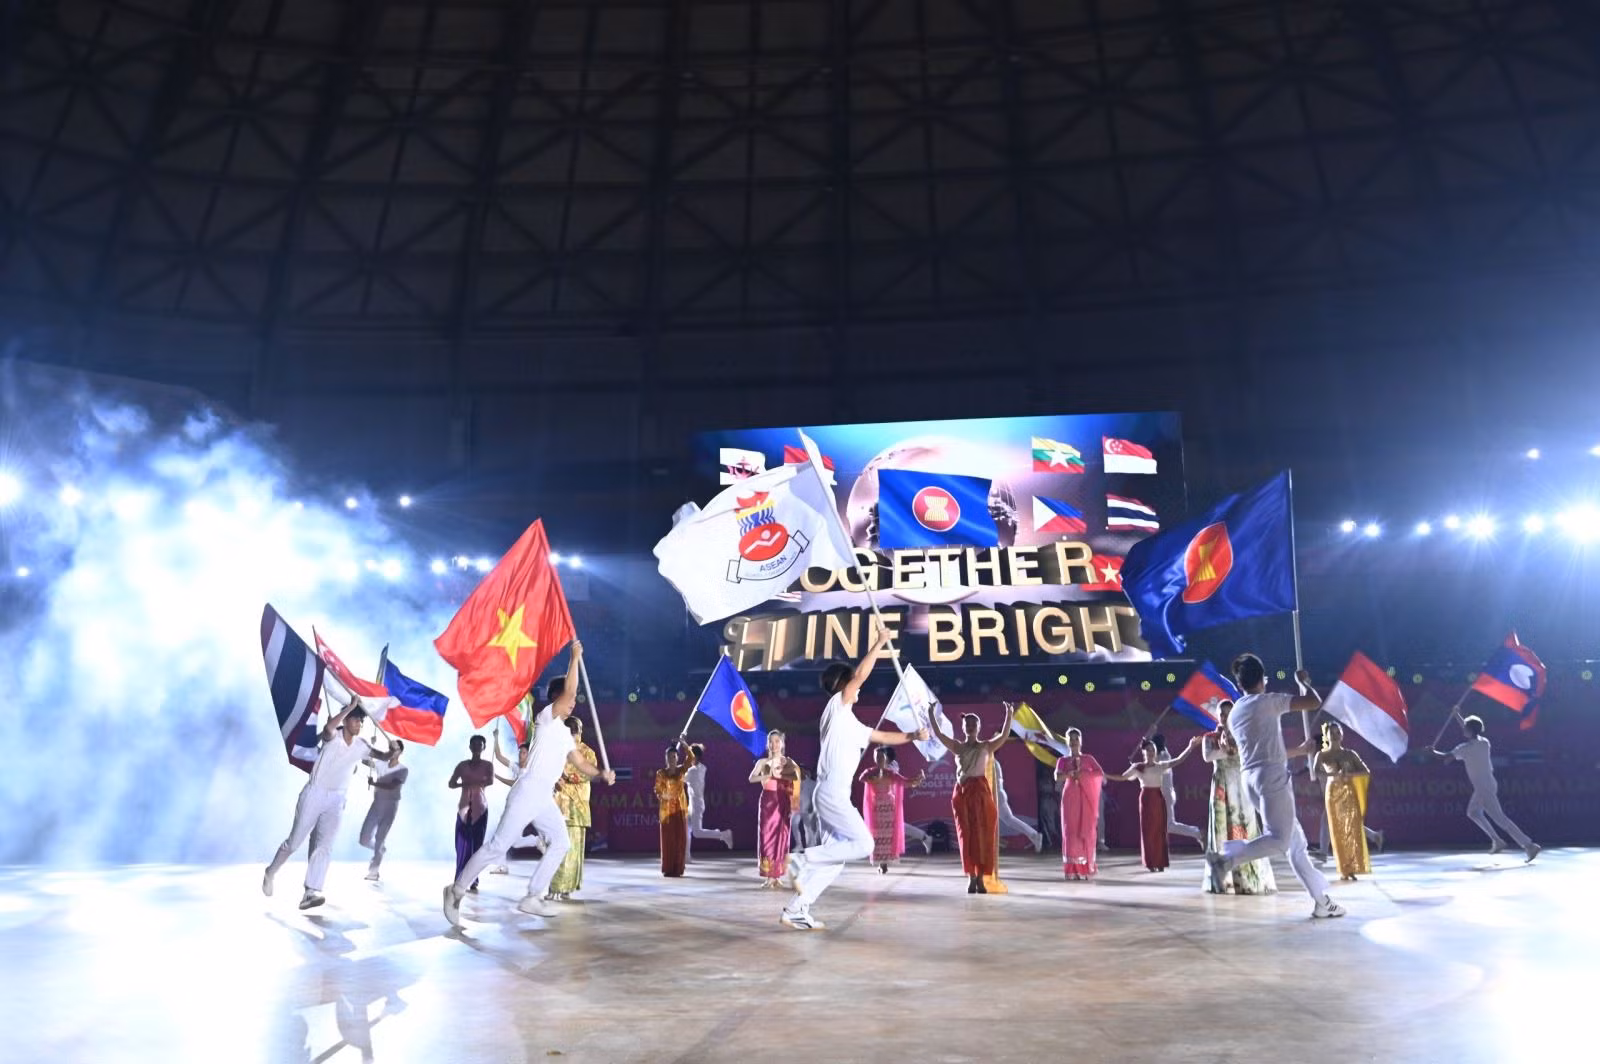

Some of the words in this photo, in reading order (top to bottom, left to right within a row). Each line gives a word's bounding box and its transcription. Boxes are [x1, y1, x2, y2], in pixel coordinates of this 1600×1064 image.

[759, 554, 787, 572] ASEAN
[799, 541, 1098, 593] OGETHER
[613, 813, 660, 826] VIETNA
